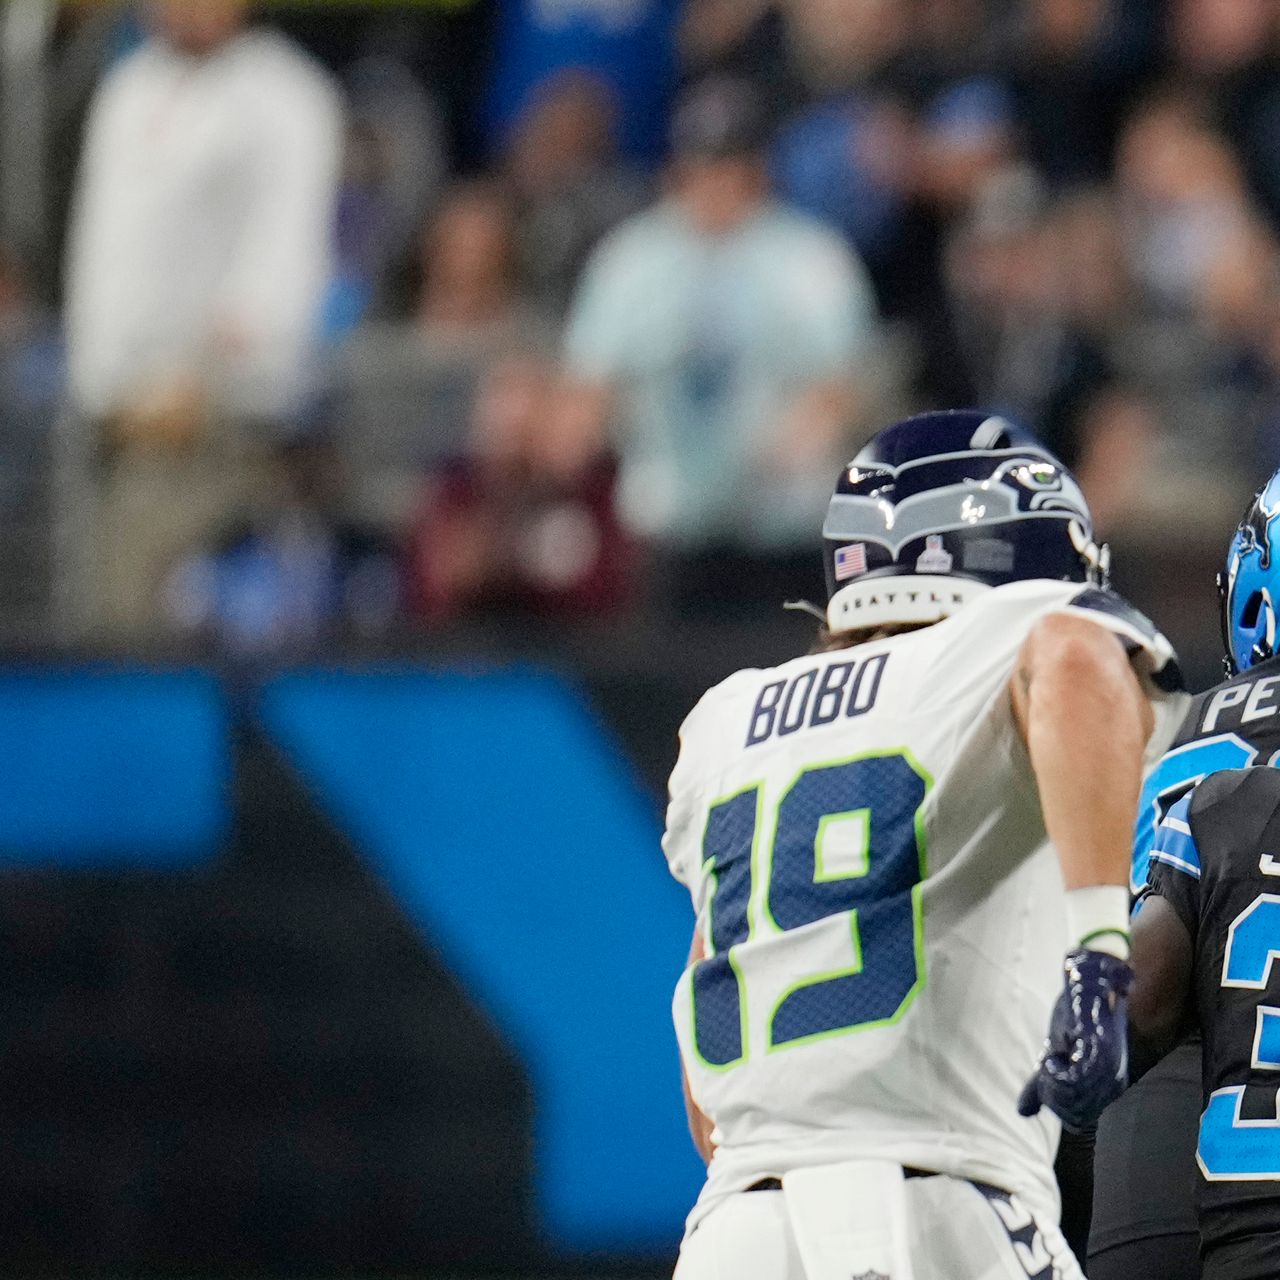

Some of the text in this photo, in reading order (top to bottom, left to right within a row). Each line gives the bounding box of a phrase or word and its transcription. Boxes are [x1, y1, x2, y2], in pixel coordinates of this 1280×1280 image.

[842, 591, 963, 612] SEATTLE
[745, 652, 890, 748] BOBO
[689, 745, 934, 1073] 19
